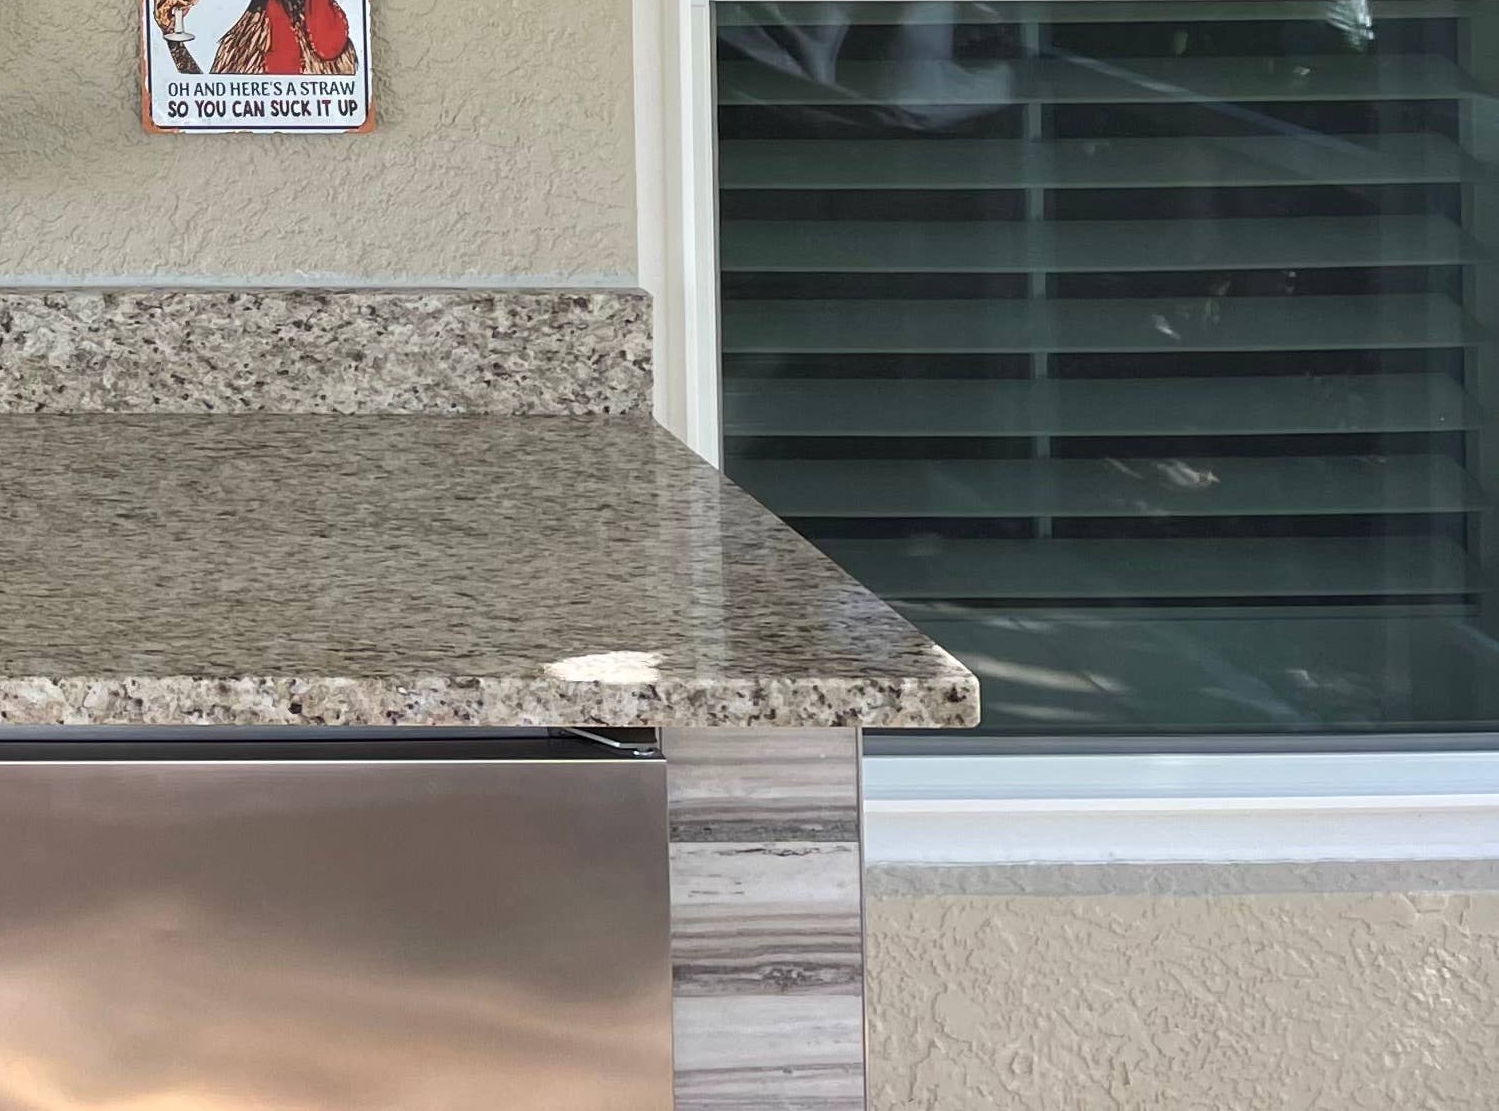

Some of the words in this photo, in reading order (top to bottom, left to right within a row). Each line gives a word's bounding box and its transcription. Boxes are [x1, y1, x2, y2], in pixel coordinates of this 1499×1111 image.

[168, 82, 190, 96] OH
[194, 82, 226, 96] AND
[230, 81, 283, 96] HERE'S
[286, 81, 297, 96] A
[300, 80, 356, 96] STRAW
[167, 100, 189, 118] SO
[195, 100, 227, 118] YOU
[232, 100, 265, 118] CAN
[270, 99, 312, 117] SUCK
[317, 99, 332, 117] IT
[338, 99, 359, 117] UP
